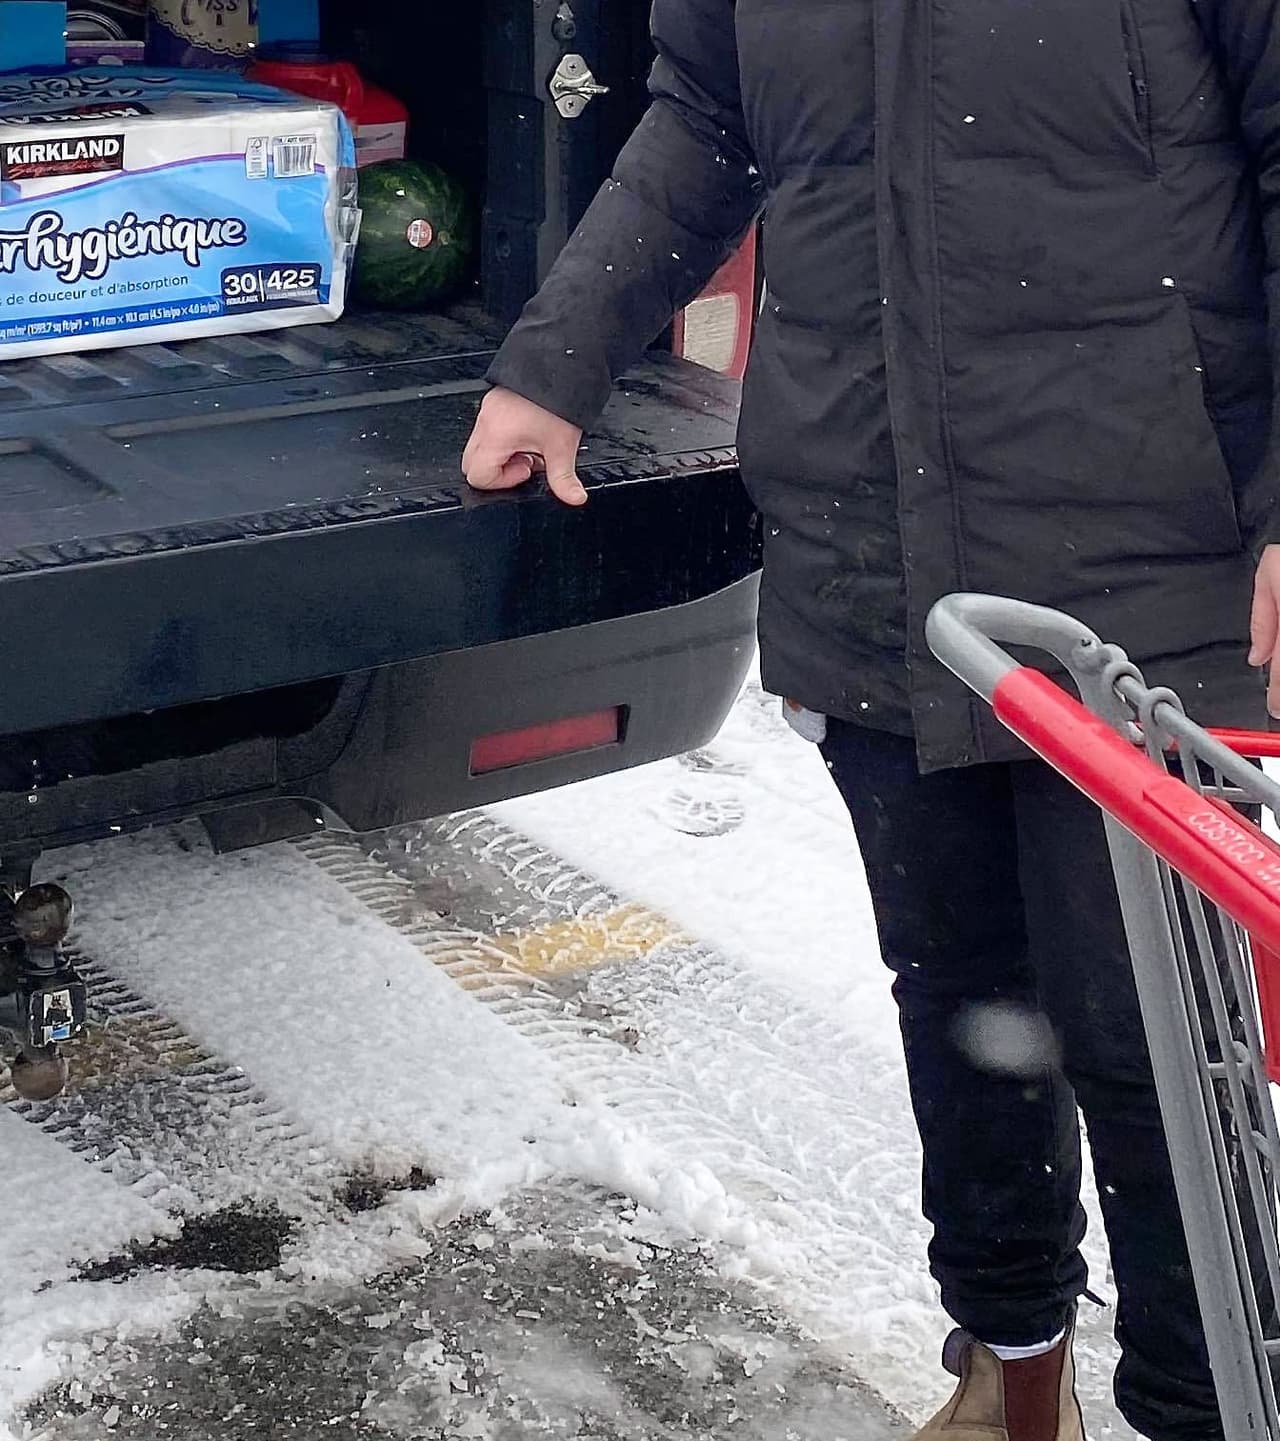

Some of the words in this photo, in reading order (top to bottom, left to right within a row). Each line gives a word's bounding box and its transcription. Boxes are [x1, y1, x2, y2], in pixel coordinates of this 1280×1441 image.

[7, 139, 120, 164] KIRKLAND
[7, 292, 24, 305] de
[29, 288, 86, 303] douceur
[91, 285, 103, 296] et
[107, 274, 188, 295] d'absorption
[224, 273, 256, 295] 30
[267, 269, 315, 290] 425
[1188, 811, 1263, 873] COSTCO
